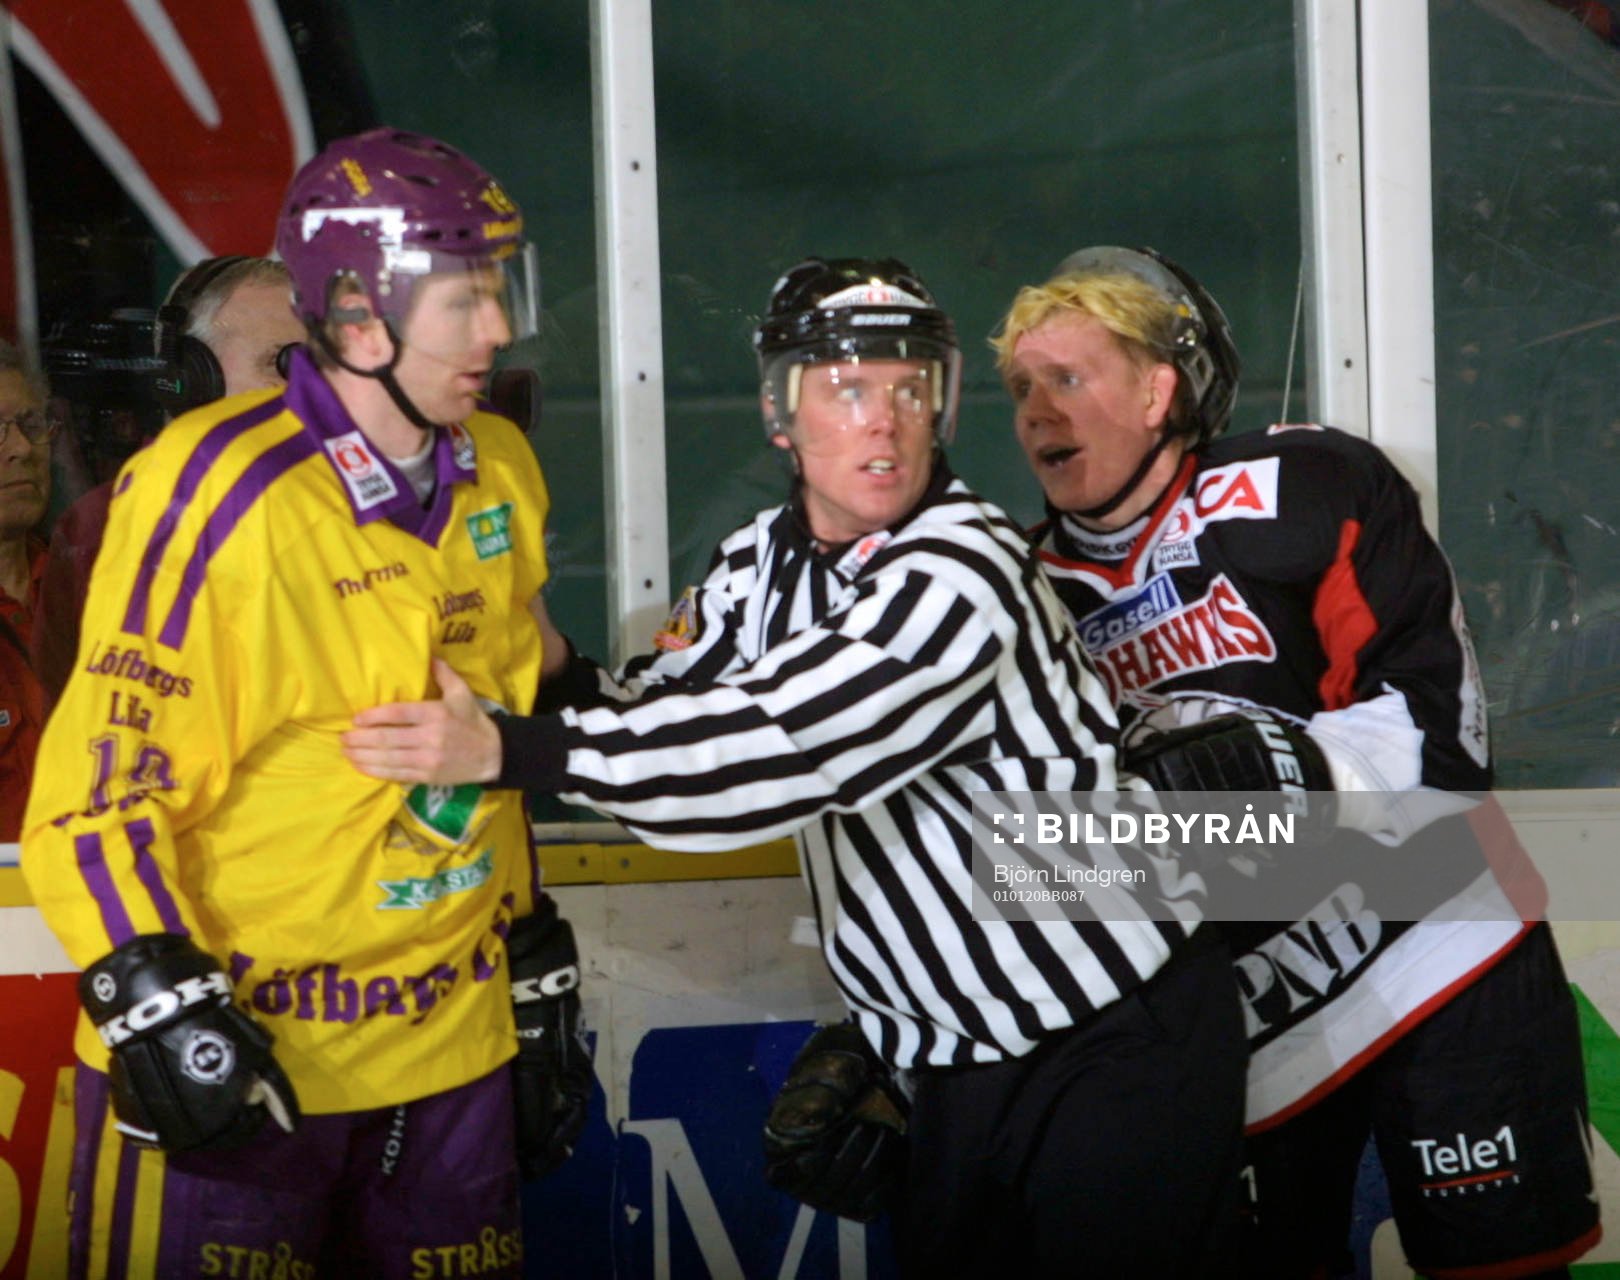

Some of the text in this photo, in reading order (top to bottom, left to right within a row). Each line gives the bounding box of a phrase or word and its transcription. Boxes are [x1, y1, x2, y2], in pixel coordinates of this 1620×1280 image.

[1158, 551, 1196, 566] HANSA
[1083, 573, 1171, 645] Gasell
[1411, 1125, 1517, 1177] Tele1
